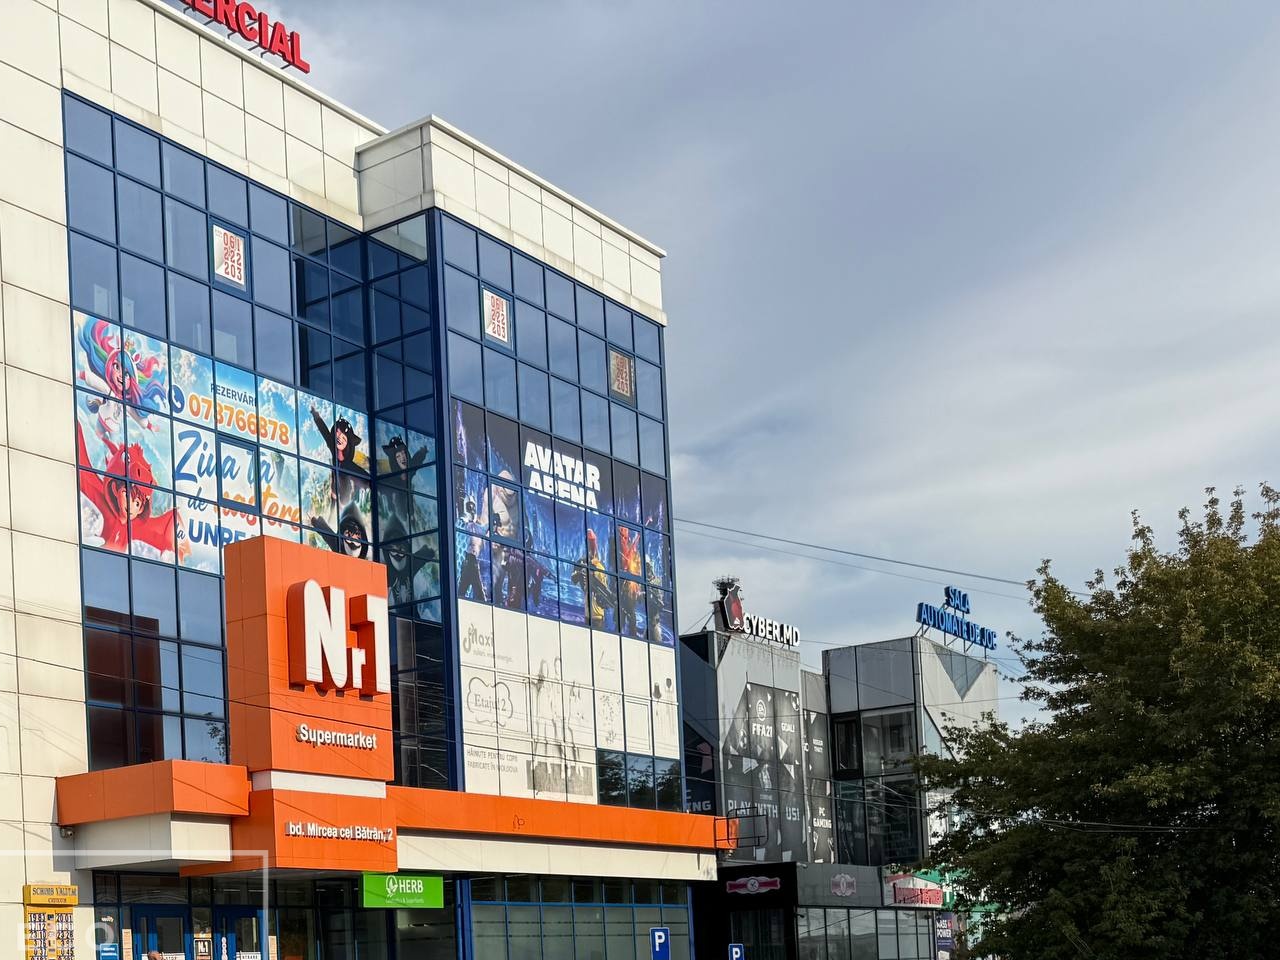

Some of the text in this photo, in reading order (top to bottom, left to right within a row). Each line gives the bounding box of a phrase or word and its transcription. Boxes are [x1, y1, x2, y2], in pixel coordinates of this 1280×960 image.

[524, 441, 601, 491] AVATAR
[528, 471, 599, 515] ARENA
[945, 586, 970, 614] SALA
[743, 611, 800, 647] CYBER.MD
[501, 699, 507, 711] 2
[298, 723, 377, 749] Supermarket
[289, 821, 305, 835] bd.
[307, 823, 338, 837] Mircea
[340, 826, 353, 839] cel
[399, 879, 424, 893] HERB
[655, 932, 665, 952] P
